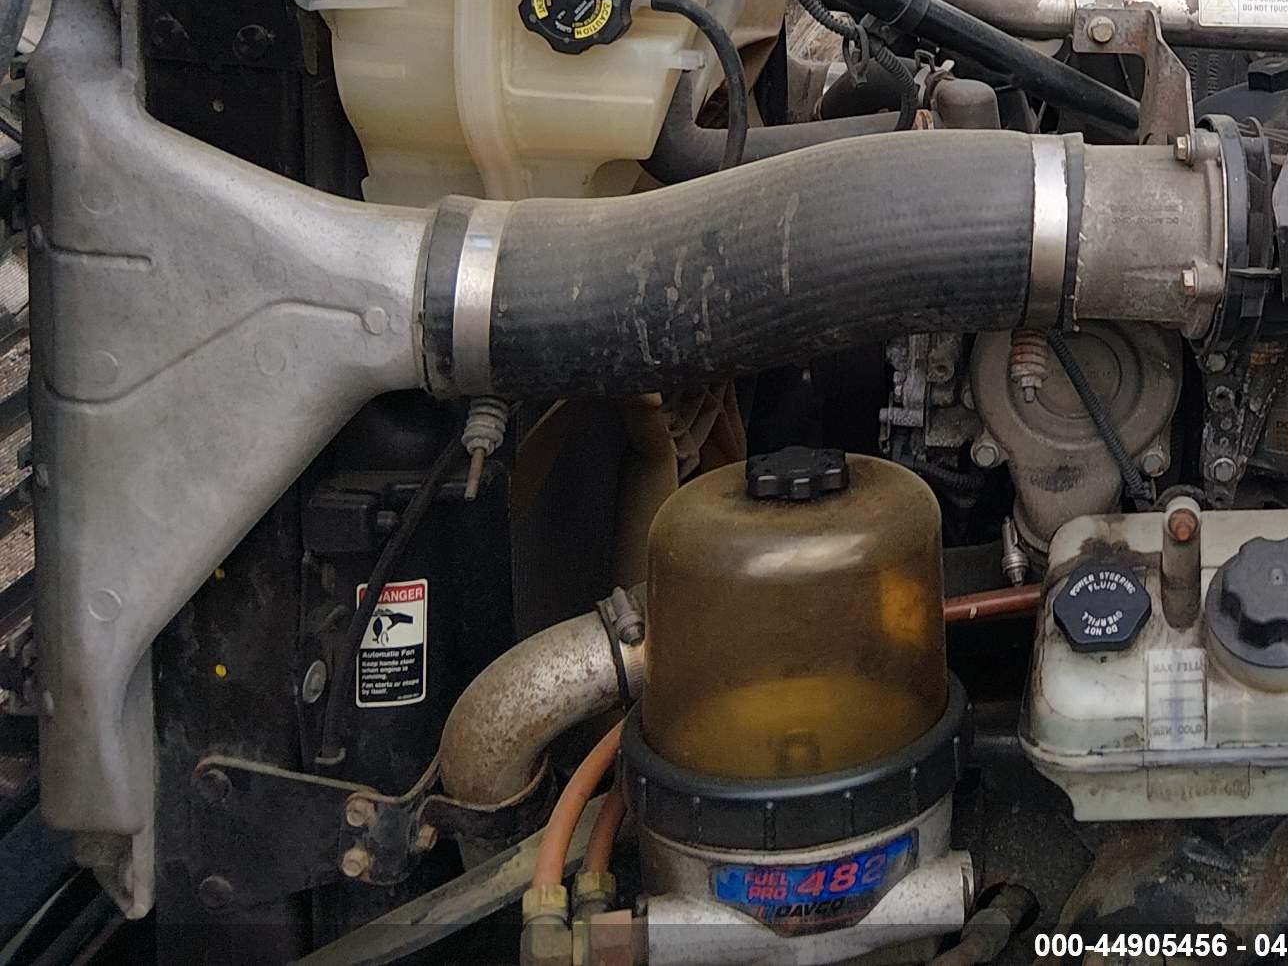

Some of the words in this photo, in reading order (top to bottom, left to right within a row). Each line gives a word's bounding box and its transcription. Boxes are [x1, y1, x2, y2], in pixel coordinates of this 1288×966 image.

[1254, 4, 1268, 12] NOT
[576, 5, 611, 38] CAUTION
[1070, 574, 1096, 597] POWER
[1099, 572, 1136, 595] STEERING
[1087, 581, 1117, 593] FLUID
[380, 587, 424, 603] ANGER
[1081, 610, 1124, 627] OVERFILL
[1084, 625, 1103, 636] NOT
[1105, 624, 1119, 635] DO
[362, 650, 400, 658] Automatic
[744, 871, 788, 885] FUEL
[748, 885, 788, 901] PRO
